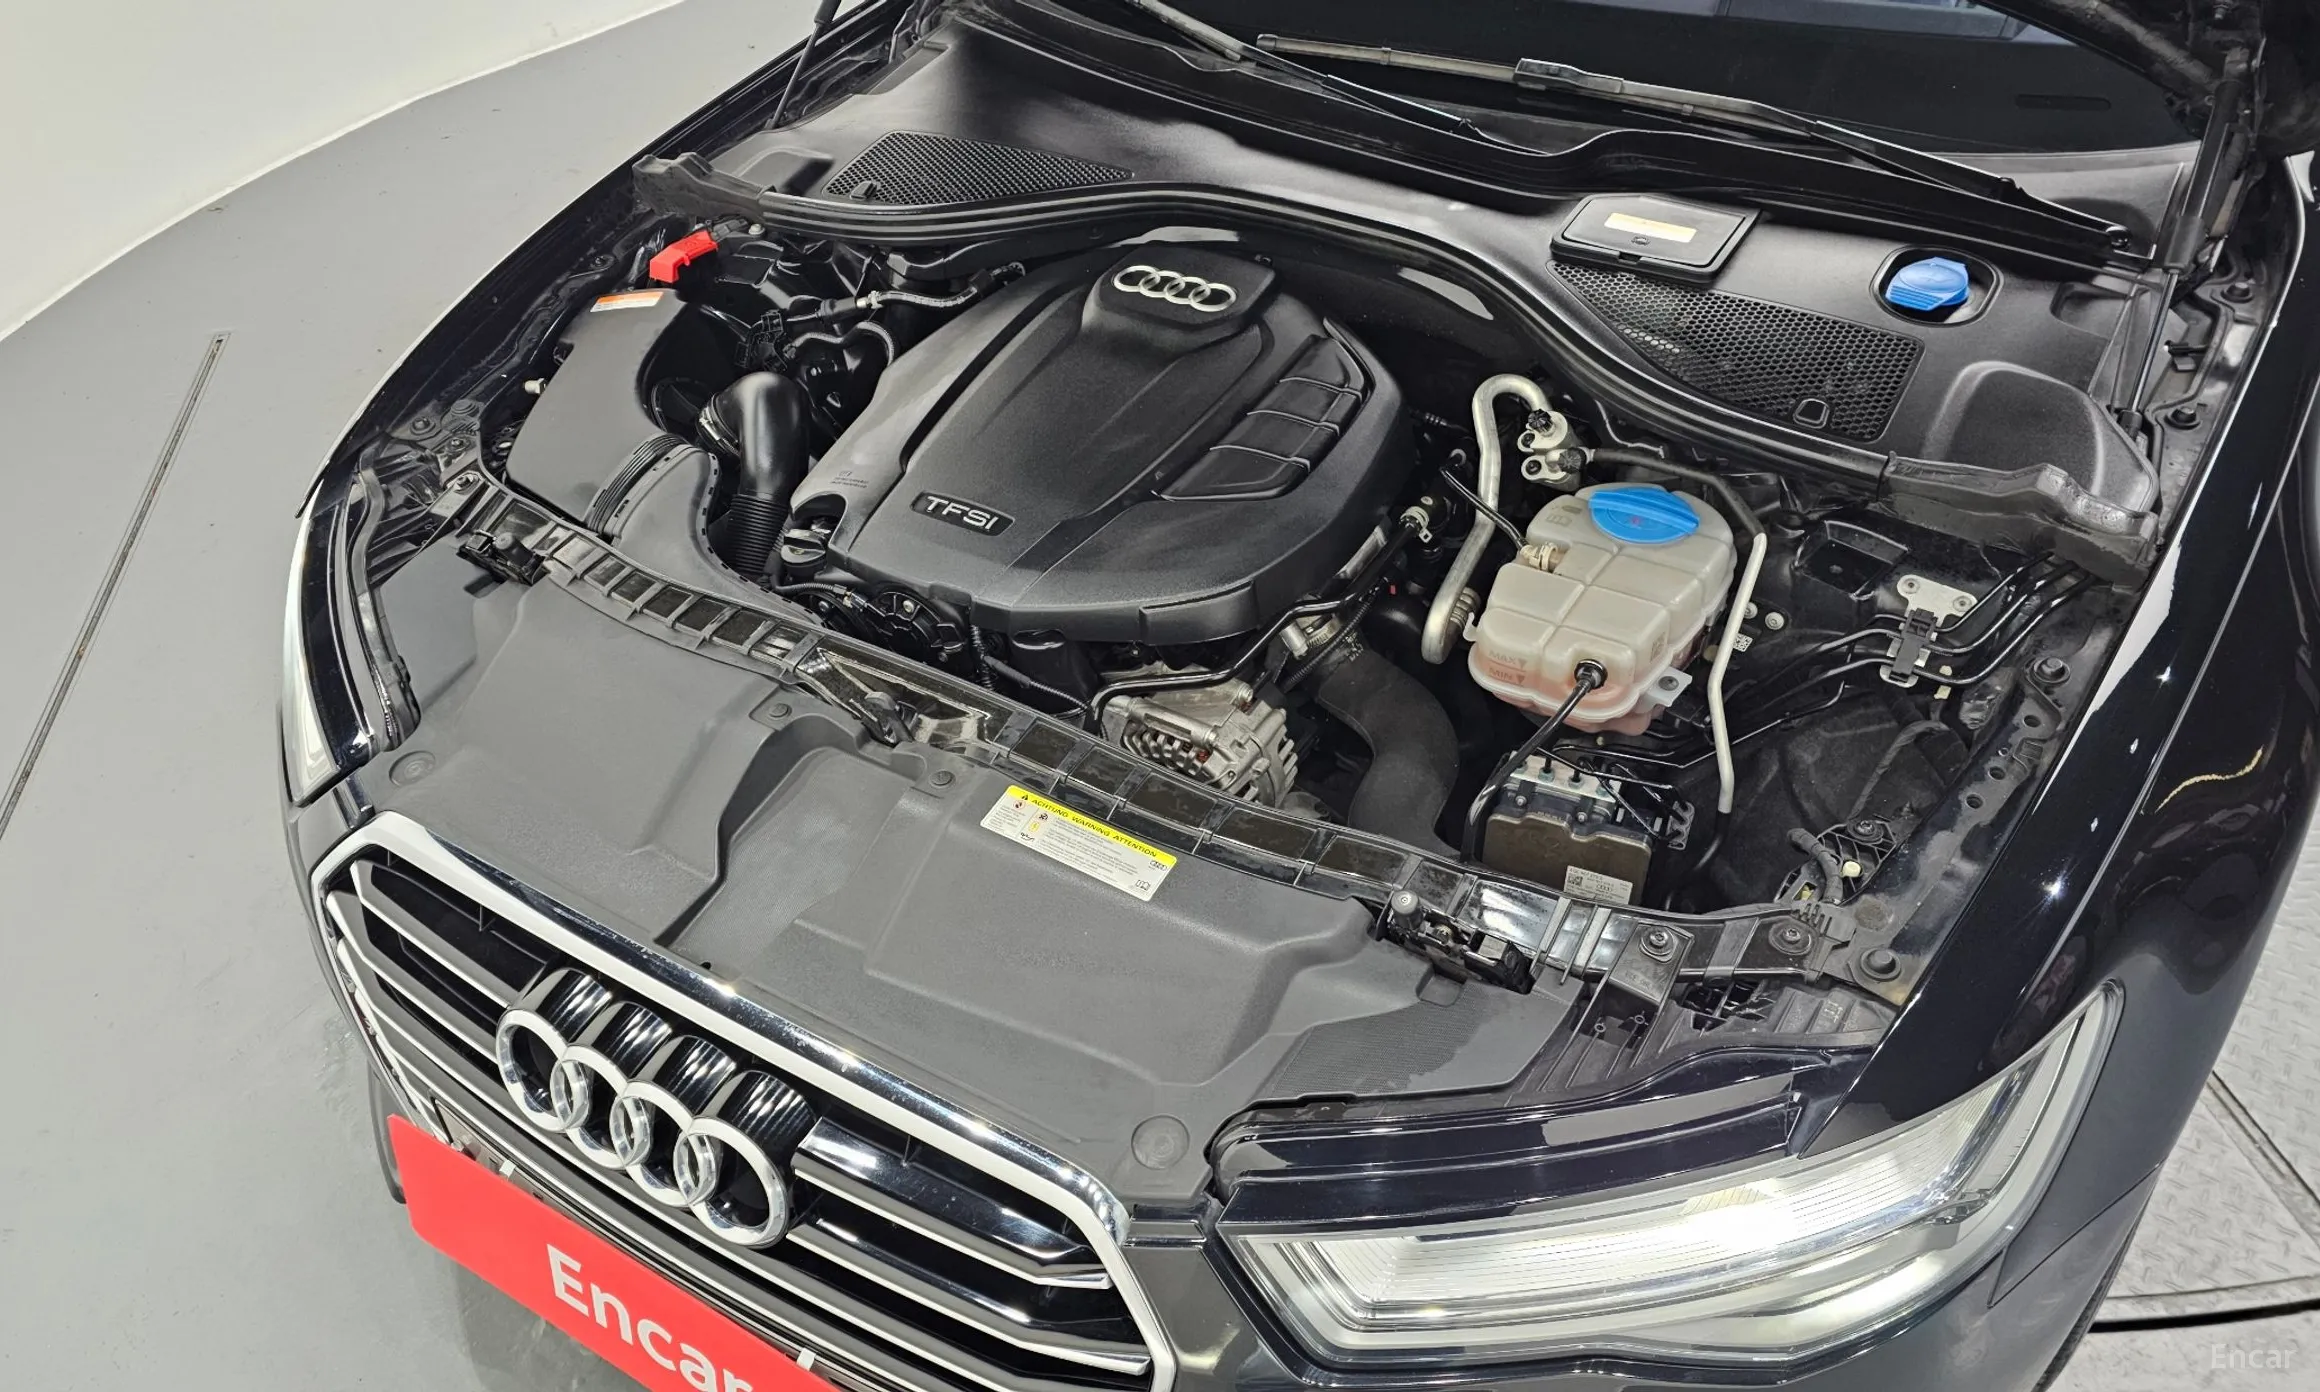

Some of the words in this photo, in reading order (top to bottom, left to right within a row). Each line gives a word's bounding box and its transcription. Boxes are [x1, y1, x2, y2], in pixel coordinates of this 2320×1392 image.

[926, 495, 999, 531] TFSI
[1031, 799, 1069, 818] ACHTUNG
[1072, 816, 1110, 838] WARNING
[1113, 832, 1157, 858] ATTENTION
[546, 1243, 753, 1392] Encar
